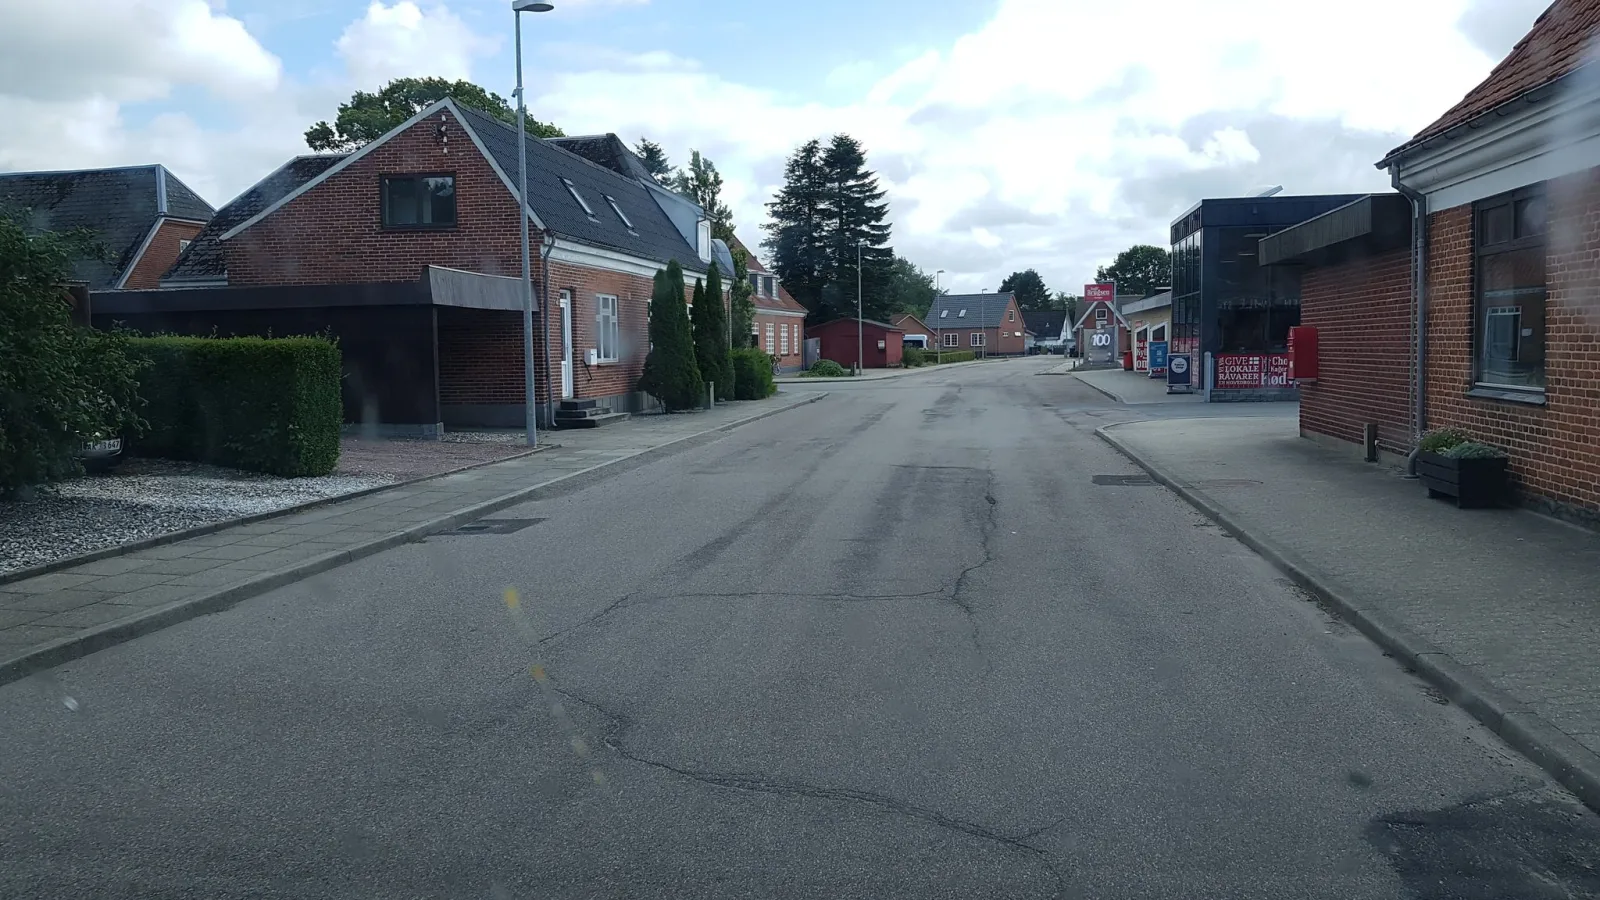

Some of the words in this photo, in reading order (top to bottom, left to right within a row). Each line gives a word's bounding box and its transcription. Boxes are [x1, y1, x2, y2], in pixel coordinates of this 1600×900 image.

[1092, 334, 1110, 346] 100
[1225, 357, 1248, 365] GIVE
[1218, 372, 1259, 380] RÅVARER
